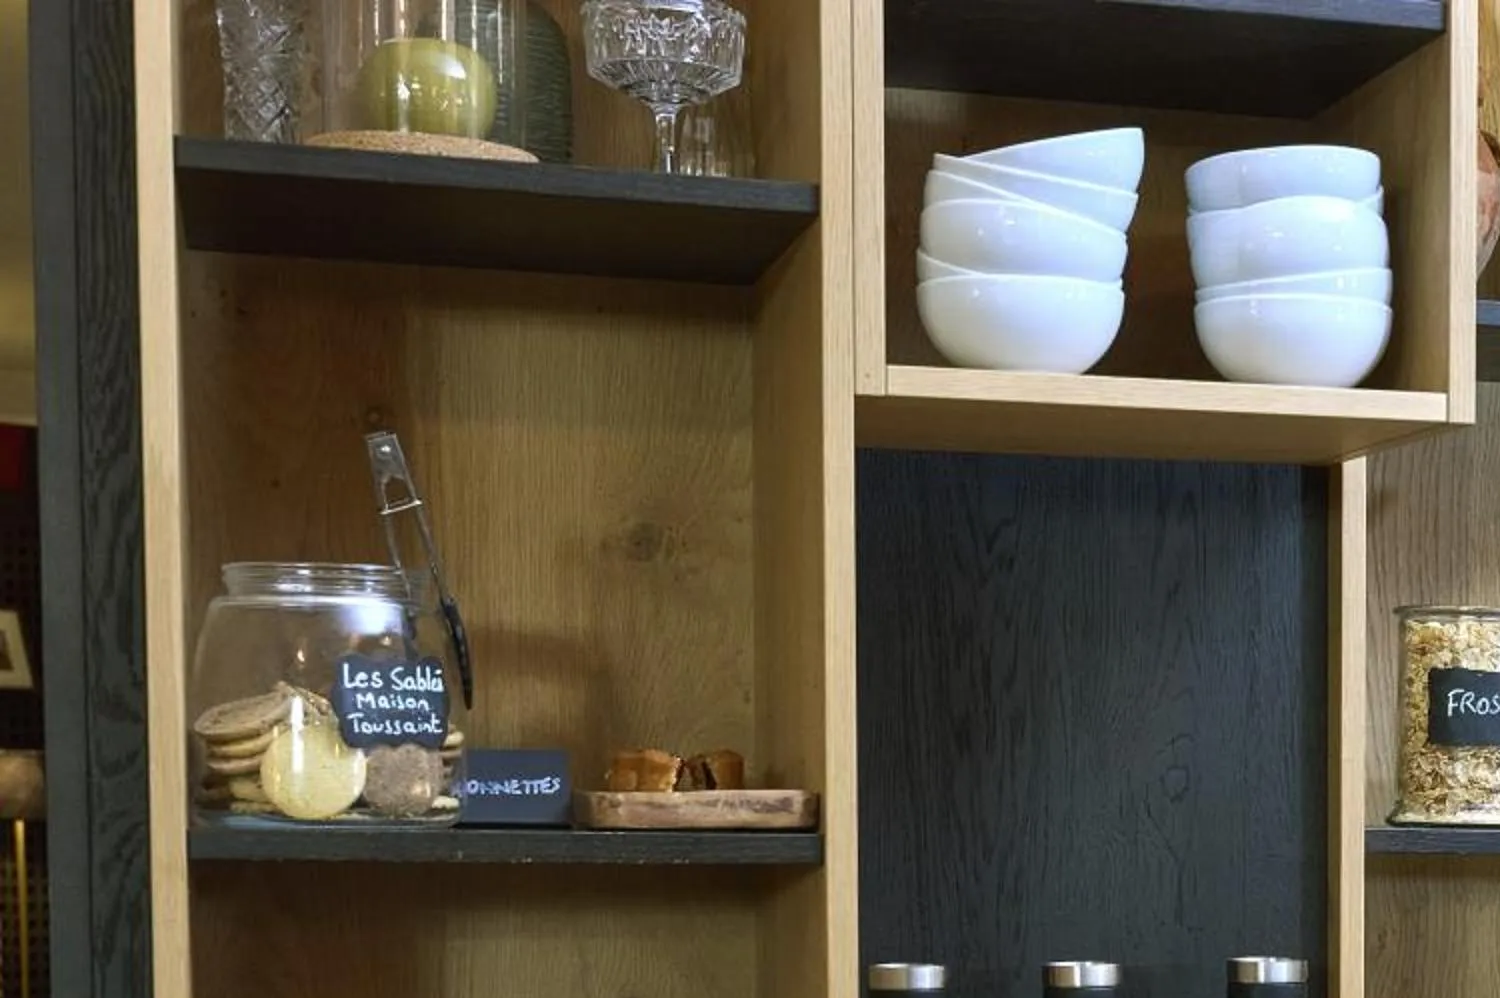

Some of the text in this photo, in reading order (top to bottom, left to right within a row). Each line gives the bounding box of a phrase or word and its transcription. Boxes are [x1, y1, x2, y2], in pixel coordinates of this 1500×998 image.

[342, 663, 384, 689] Les
[355, 692, 430, 711] Maison
[346, 712, 444, 735] Toussaint
